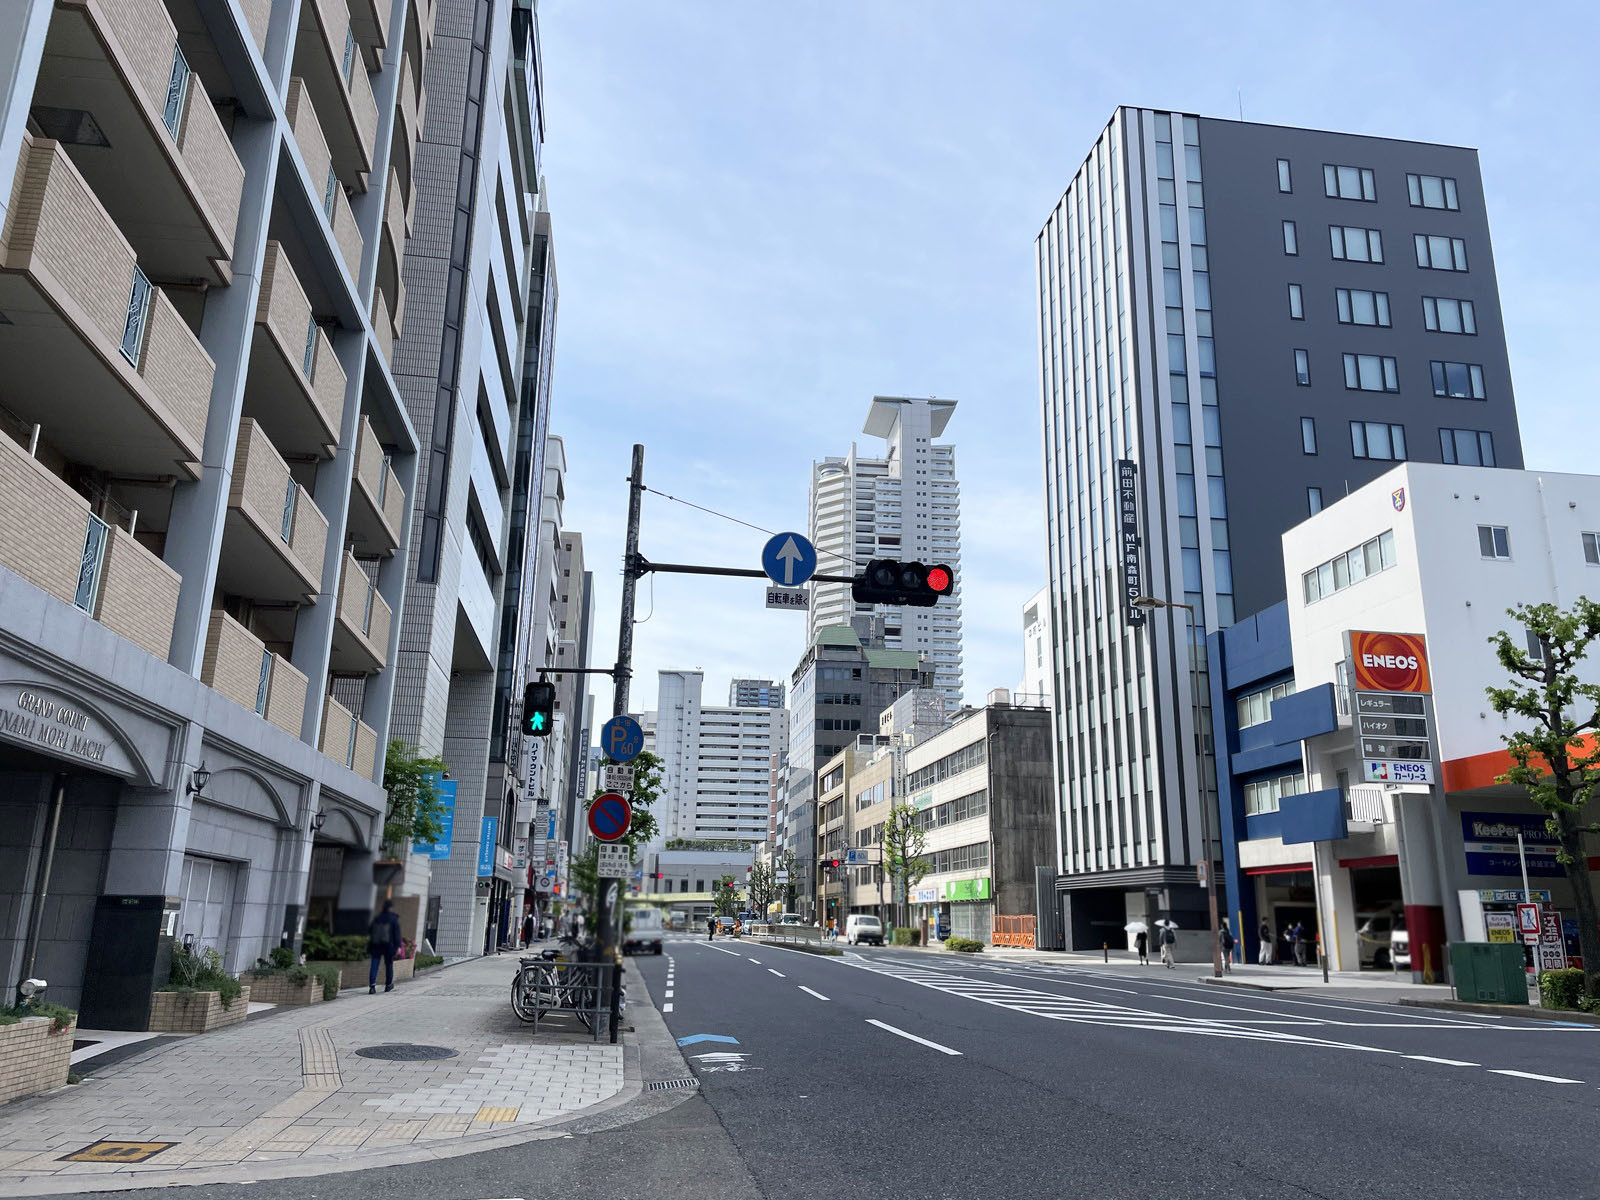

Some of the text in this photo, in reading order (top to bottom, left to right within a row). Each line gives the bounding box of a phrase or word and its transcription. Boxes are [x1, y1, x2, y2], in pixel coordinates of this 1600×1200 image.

[1121, 466, 1135, 524] 前田不動産
[767, 592, 808, 606] 自転車を除く
[1362, 653, 1418, 670] ENEOS
[1360, 699, 1391, 708] レギュラー
[18, 691, 91, 732] GRAND COURT
[1362, 721, 1388, 730] ハイオク
[38, 724, 70, 750] MORI
[71, 735, 106, 762] MACHI
[528, 743, 538, 796] ハイマウントビル
[1393, 763, 1426, 773] ENEOS
[1394, 772, 1427, 781] カーリース
[606, 780, 633, 789] ここから
[1473, 821, 1520, 838] KeePer
[1523, 830, 1541, 839] PRO
